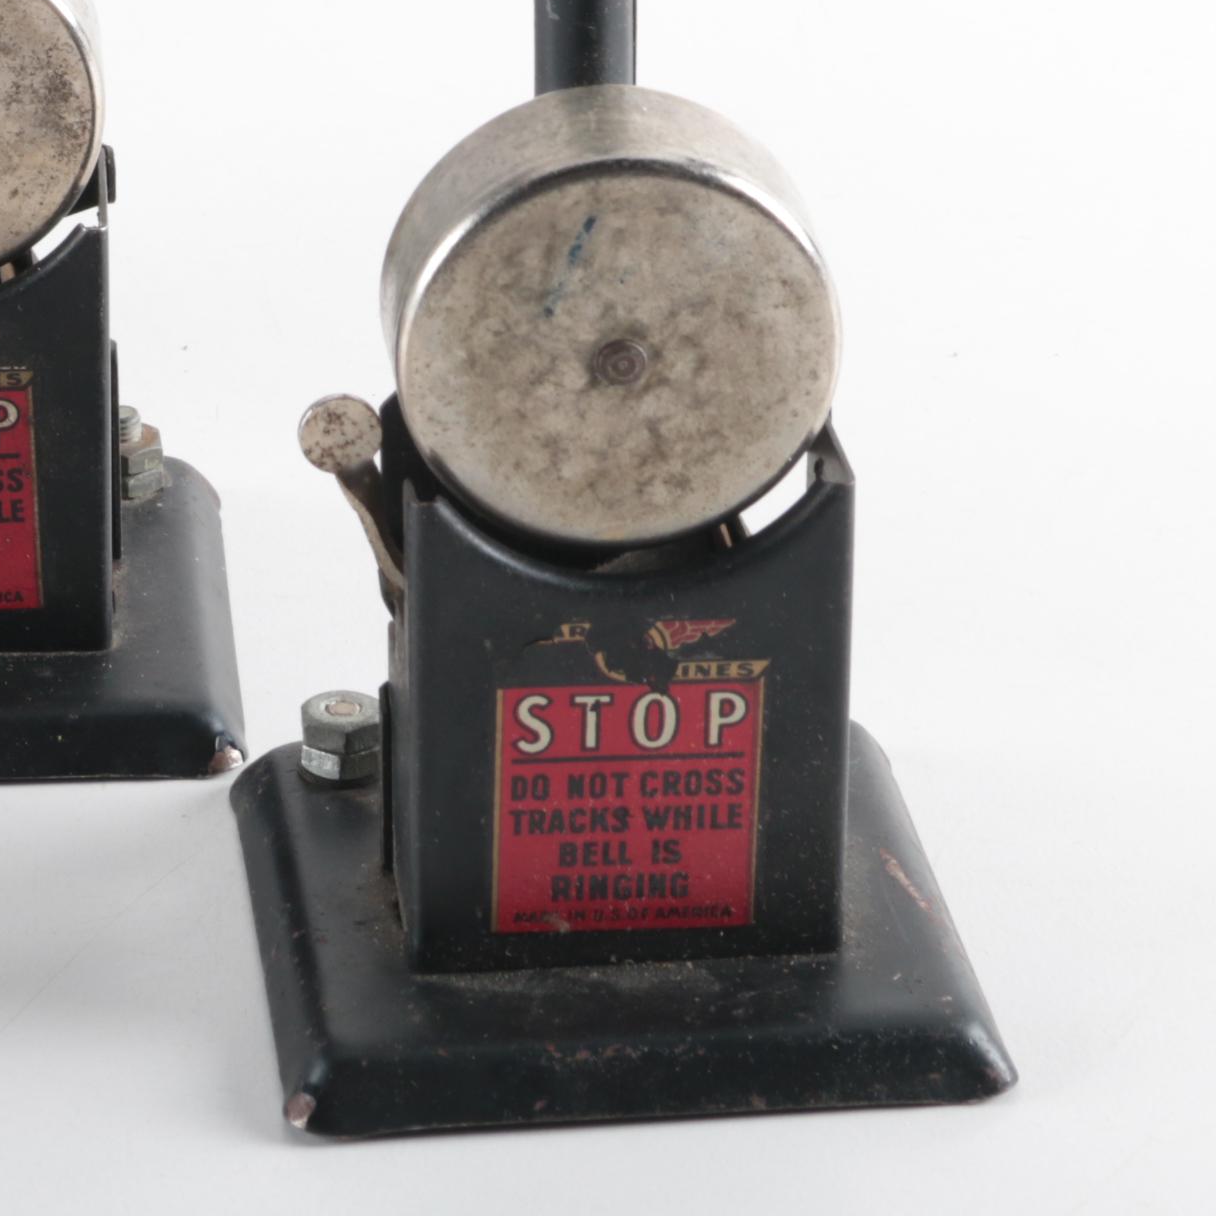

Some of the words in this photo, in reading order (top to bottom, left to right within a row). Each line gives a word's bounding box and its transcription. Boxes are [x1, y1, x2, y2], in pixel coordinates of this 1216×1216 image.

[680, 662, 754, 678] INES
[513, 690, 748, 754] STOP
[510, 774, 550, 801] DO
[568, 771, 629, 799] NOT
[640, 768, 745, 797] CROSS
[510, 806, 630, 835] TRACKS
[642, 803, 743, 831] WHILE
[559, 841, 632, 868] BELL
[651, 839, 681, 864] IS
[551, 871, 690, 903] RINGING
[655, 903, 733, 920] AMERICA
